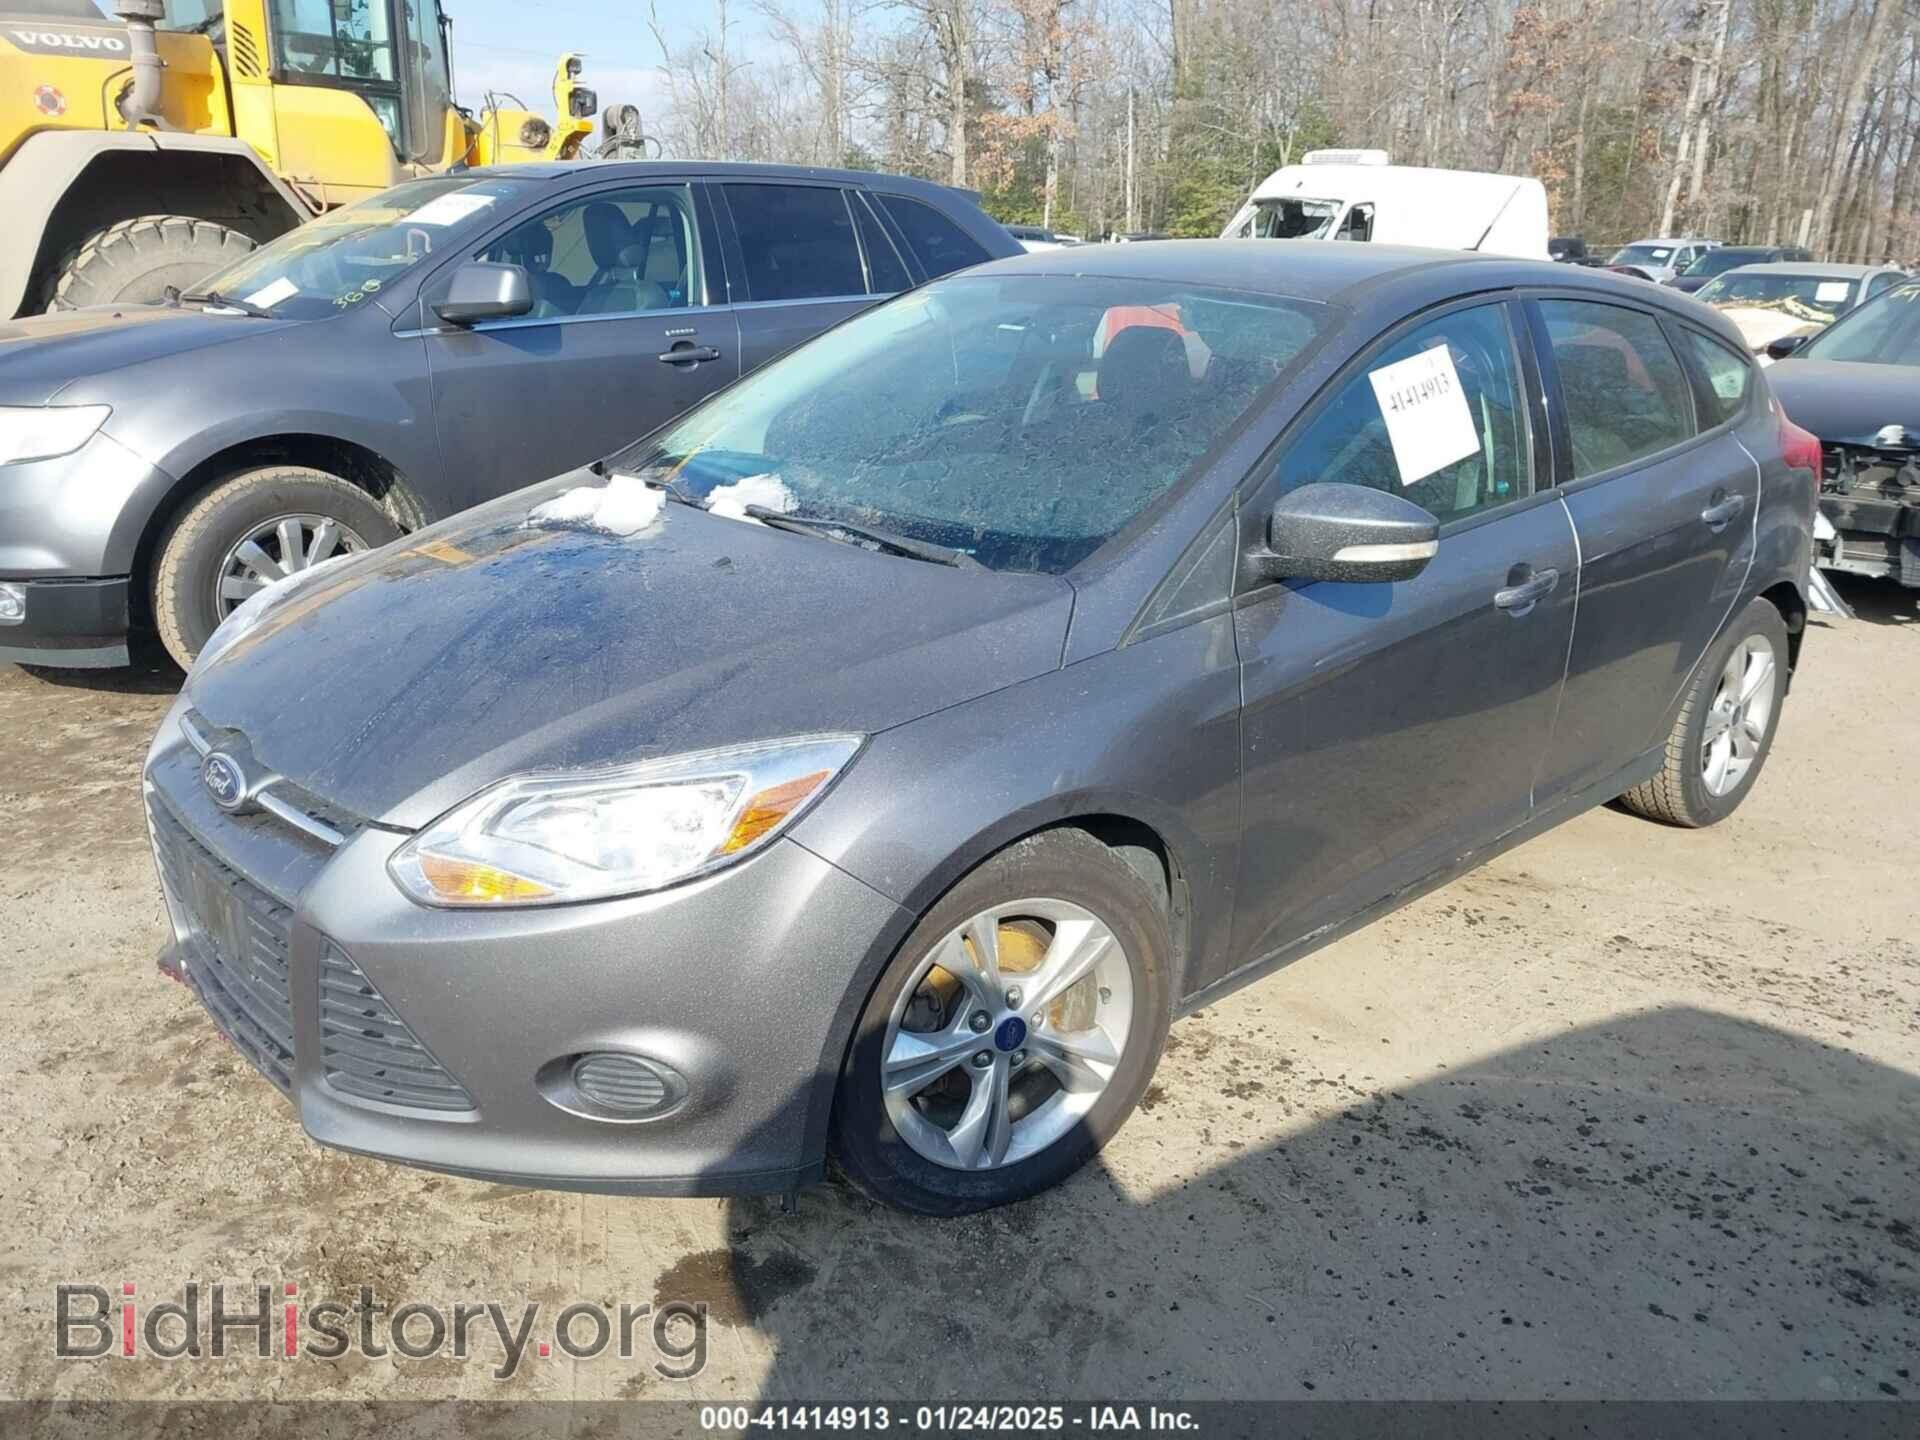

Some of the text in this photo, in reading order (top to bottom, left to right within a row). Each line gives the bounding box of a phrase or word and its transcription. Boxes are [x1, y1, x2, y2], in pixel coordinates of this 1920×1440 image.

[9, 30, 124, 51] VOLVO
[1390, 371, 1450, 412] 41414913
[204, 760, 231, 795] Ford
